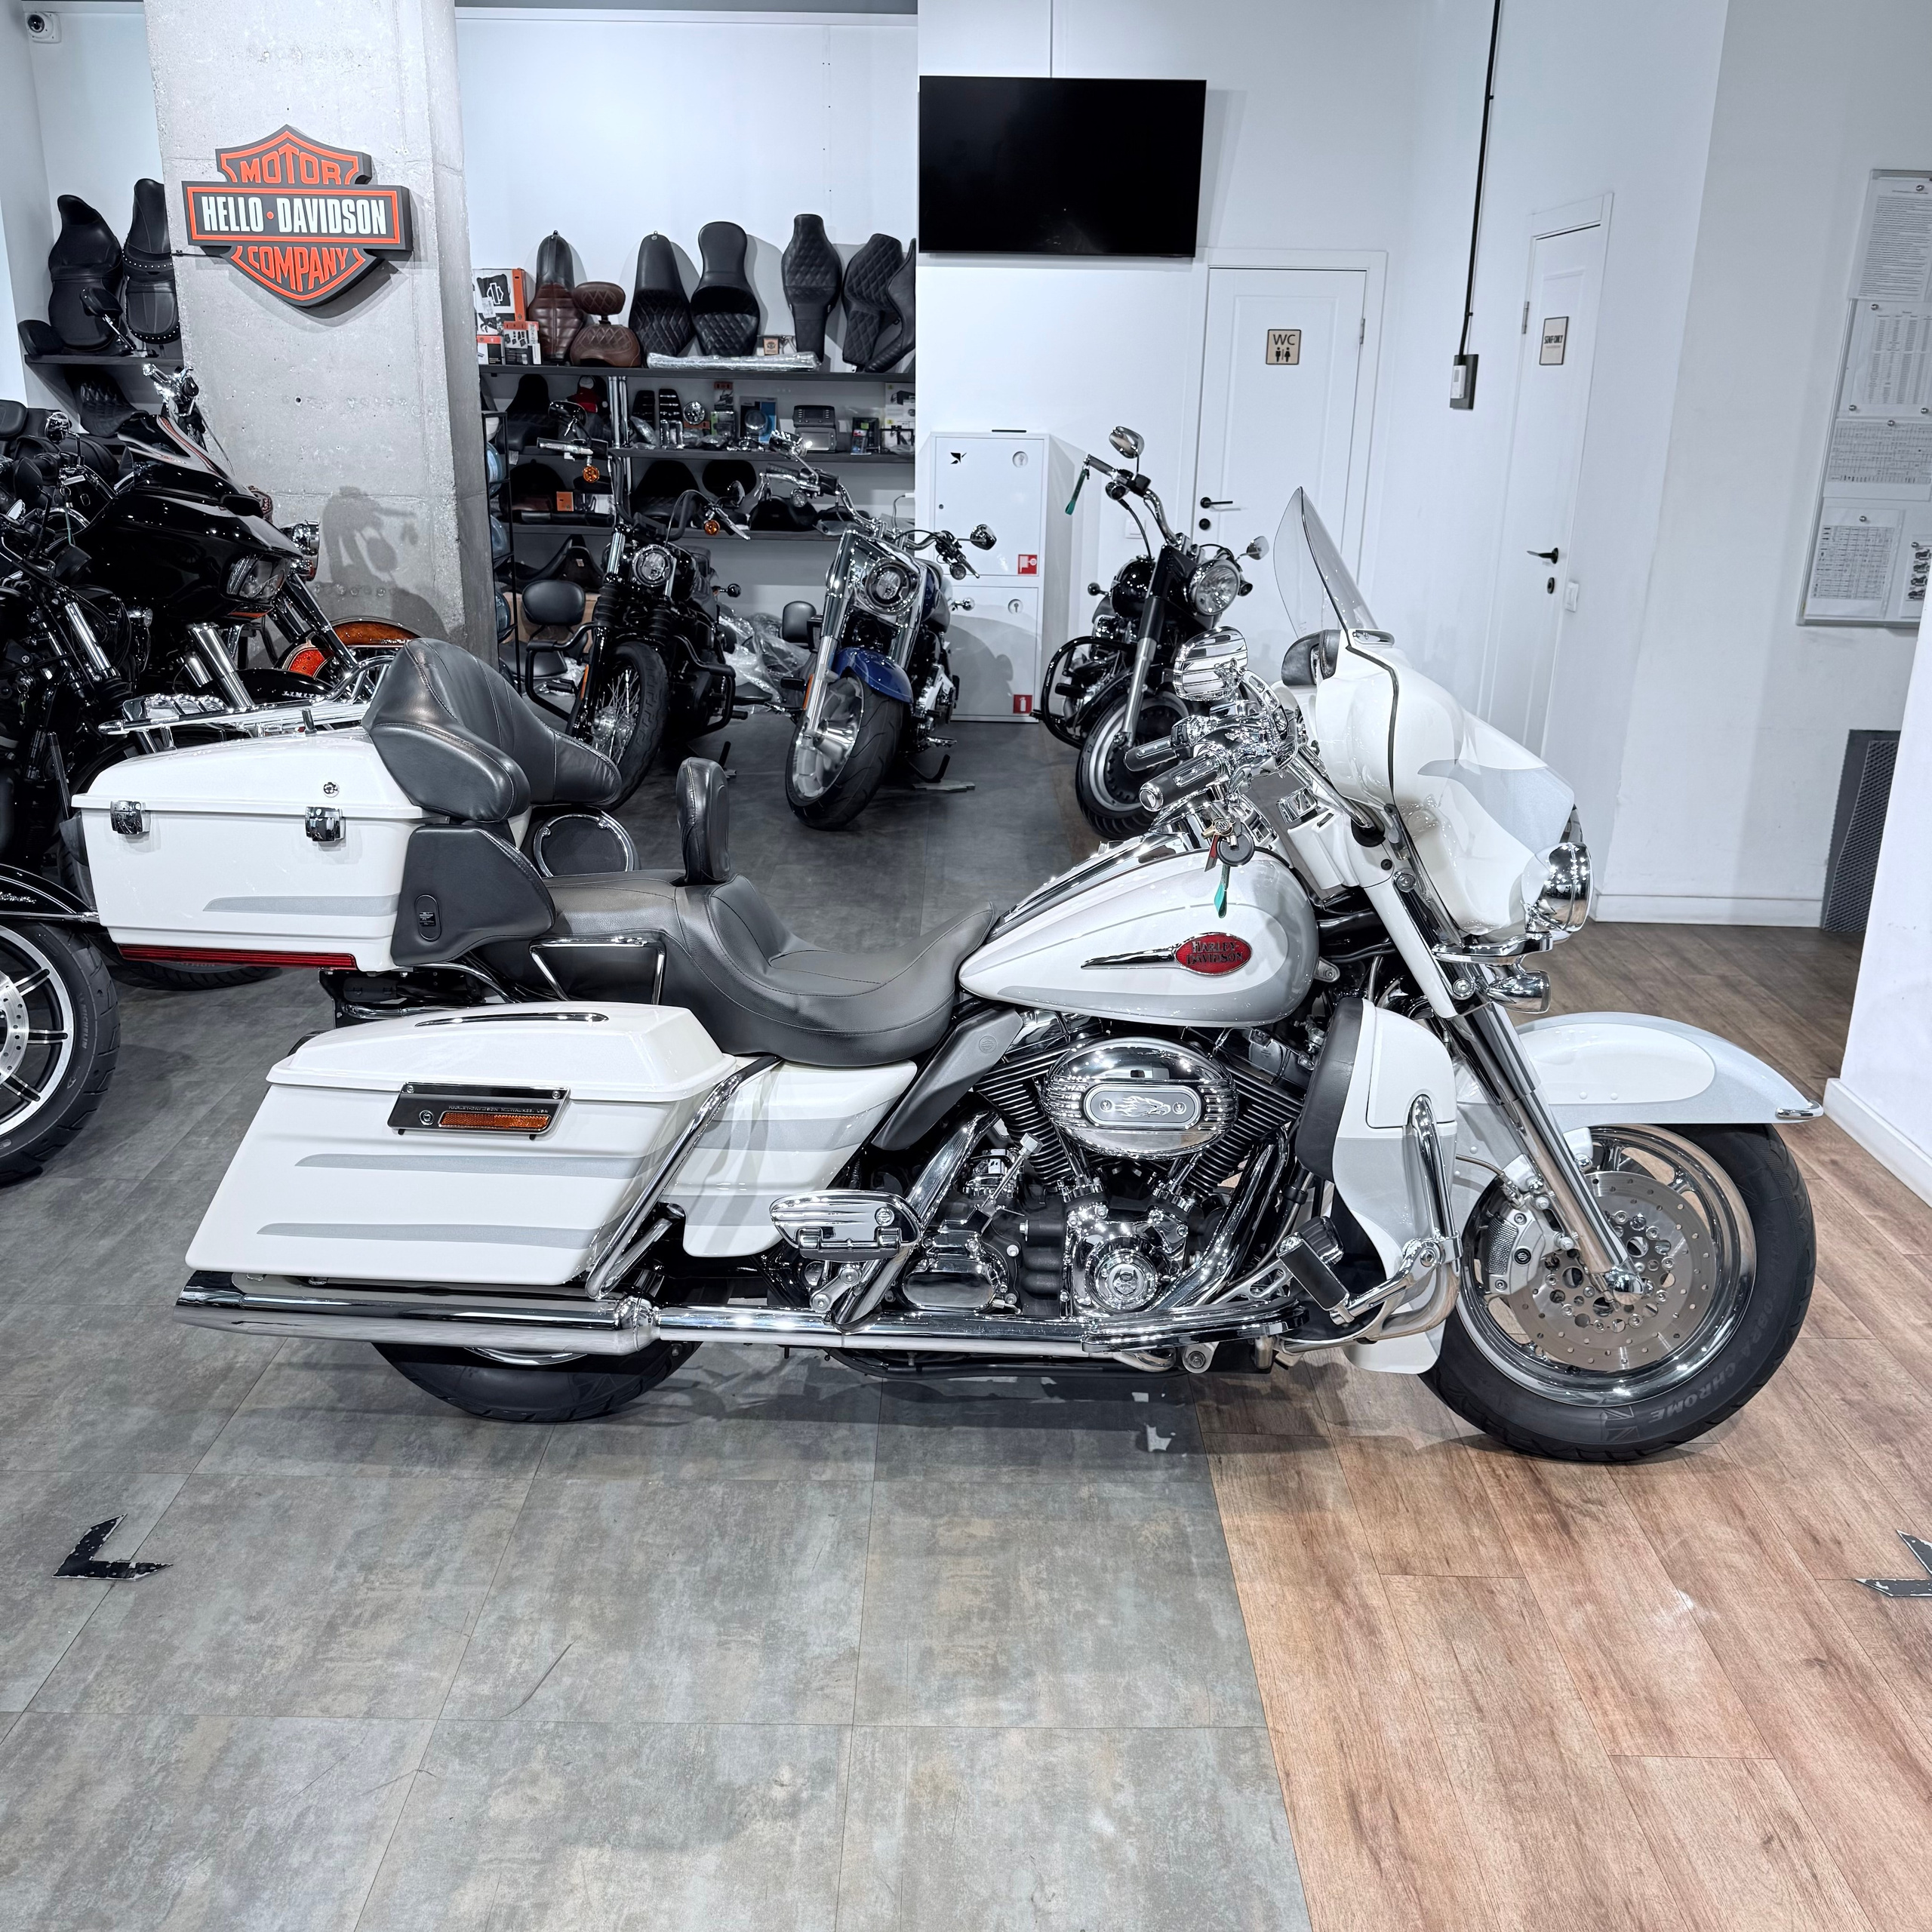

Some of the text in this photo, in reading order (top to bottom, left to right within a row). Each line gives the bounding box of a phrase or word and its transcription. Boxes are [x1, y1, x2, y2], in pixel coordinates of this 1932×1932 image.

[240, 143, 341, 186] MOTOR
[201, 195, 387, 235] HELLO DAVIDSON
[248, 245, 349, 292] COMPANY
[1272, 334, 1296, 346] WC
[1186, 952, 1243, 965] DAVIDSON
[1649, 1362, 1736, 1423] CHROME
